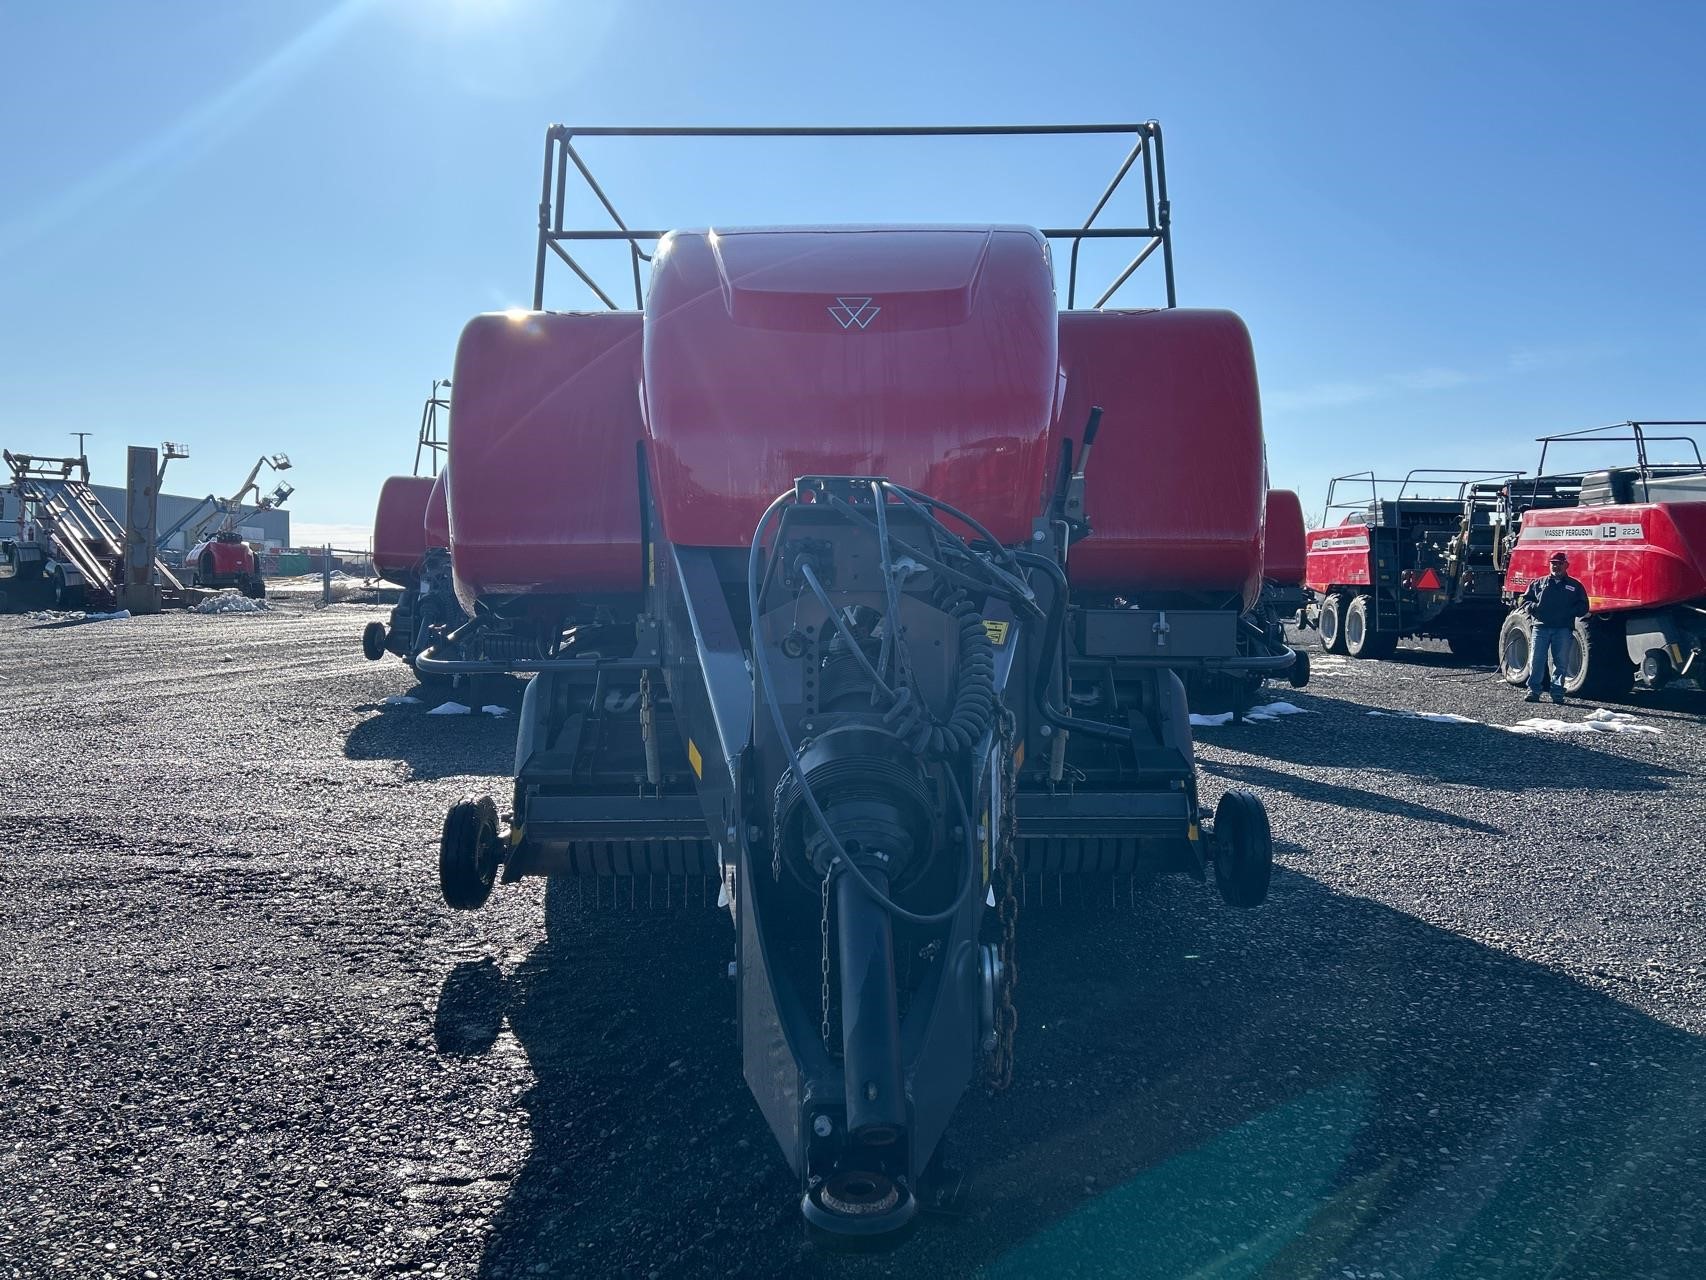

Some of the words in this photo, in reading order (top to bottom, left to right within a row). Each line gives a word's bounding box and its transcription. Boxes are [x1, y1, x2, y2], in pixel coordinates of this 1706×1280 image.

[1544, 528, 1564, 537] MASSEY
[1565, 528, 1593, 537] FERGUSON
[1602, 526, 1617, 538] LB
